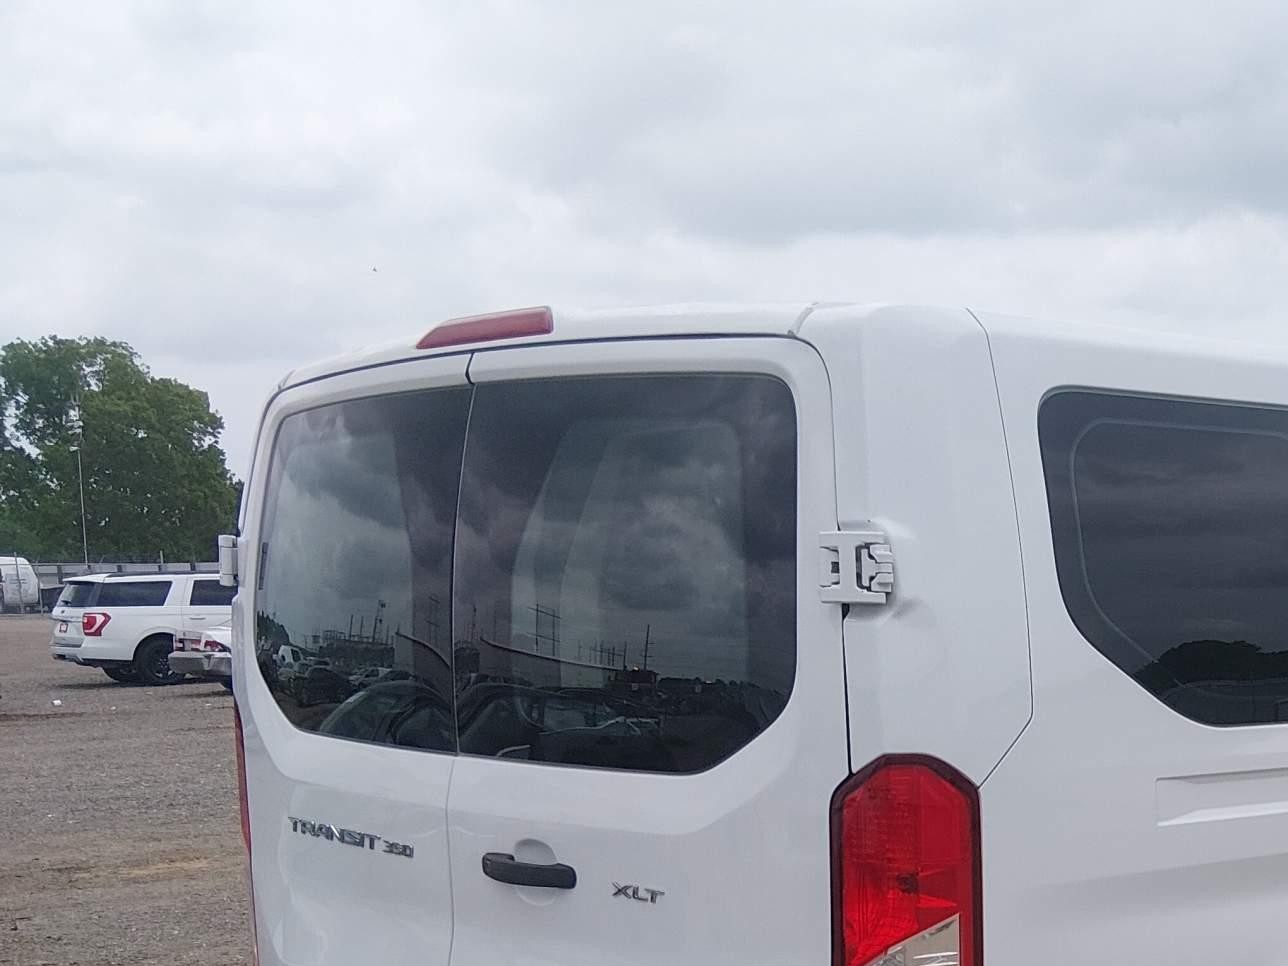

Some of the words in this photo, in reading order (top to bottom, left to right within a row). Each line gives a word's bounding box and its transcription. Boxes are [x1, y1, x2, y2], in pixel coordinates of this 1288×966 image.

[288, 816, 382, 850] TRANSIT
[382, 839, 414, 858] 350
[611, 881, 665, 904] XLT
